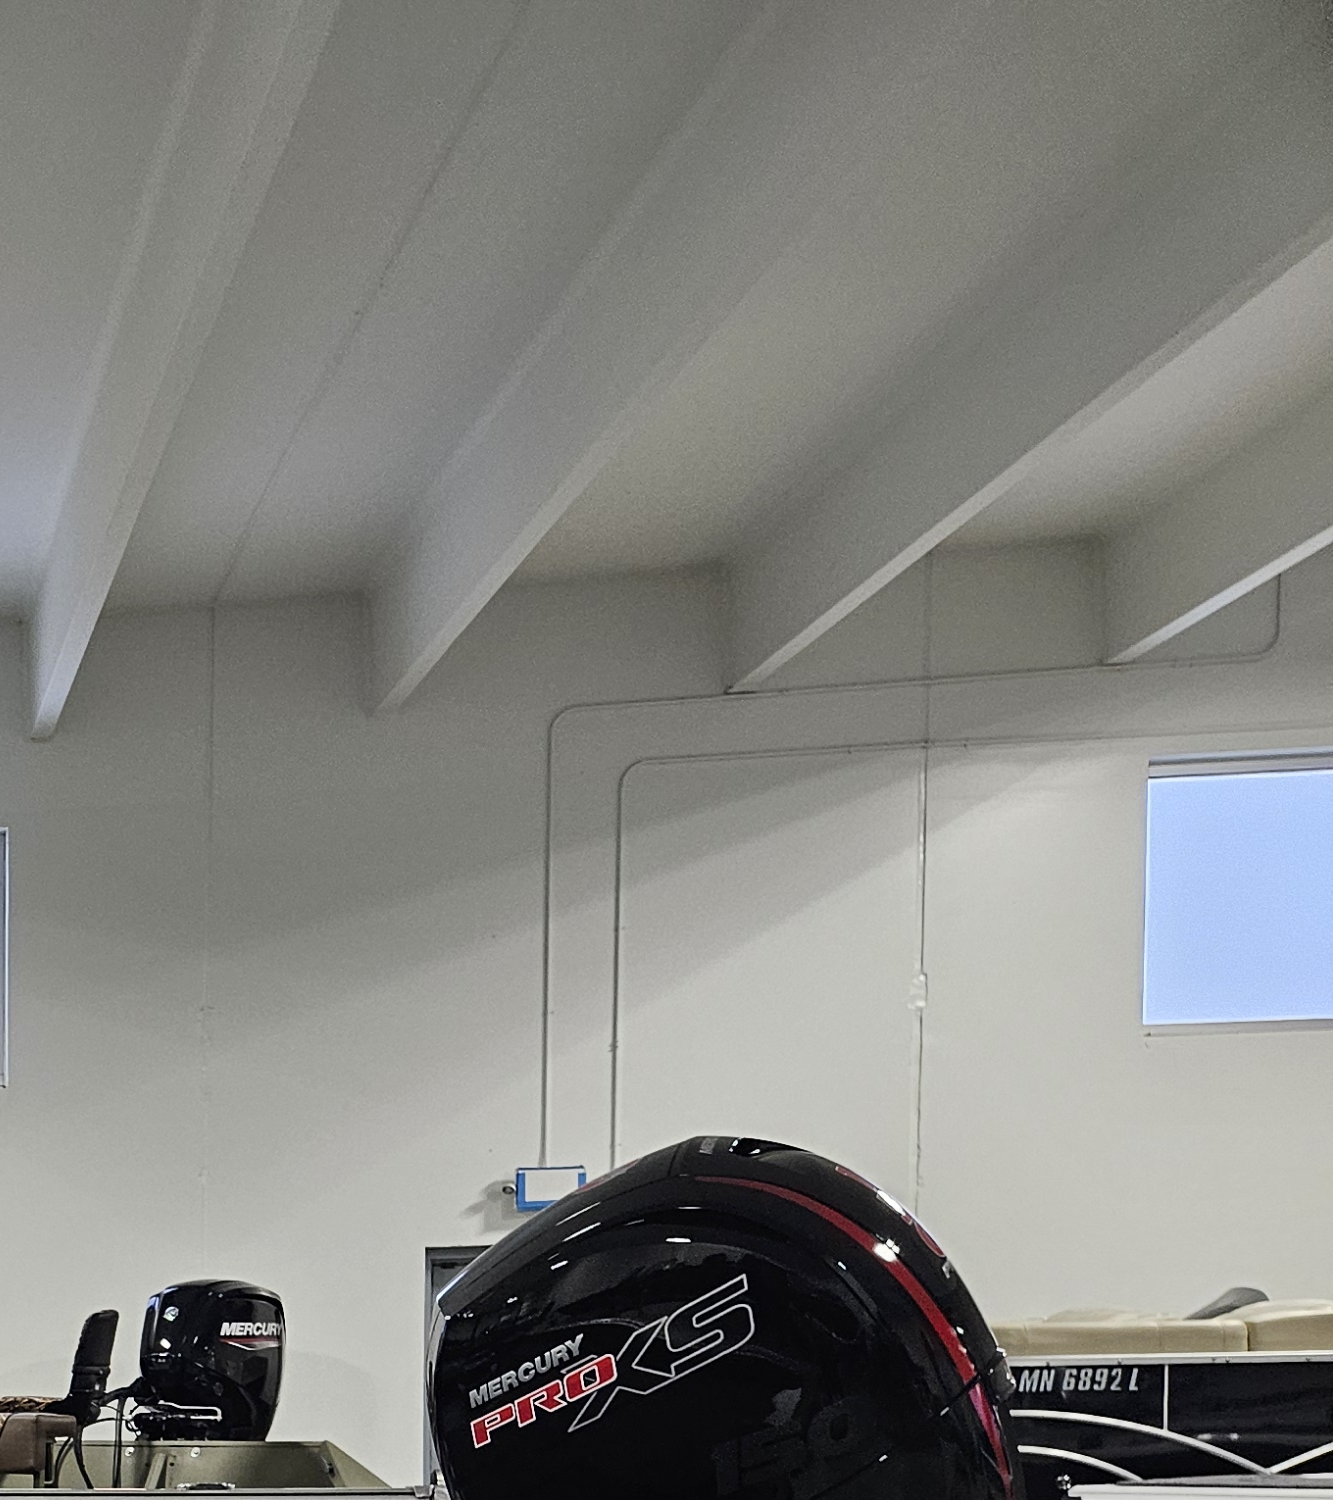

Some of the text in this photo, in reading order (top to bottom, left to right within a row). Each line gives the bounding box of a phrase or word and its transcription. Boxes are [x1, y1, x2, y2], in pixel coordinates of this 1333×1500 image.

[220, 1322, 282, 1336] MERCURY
[469, 1334, 583, 1408] MERCURY
[1018, 1368, 1139, 1392] MN 6892 L
